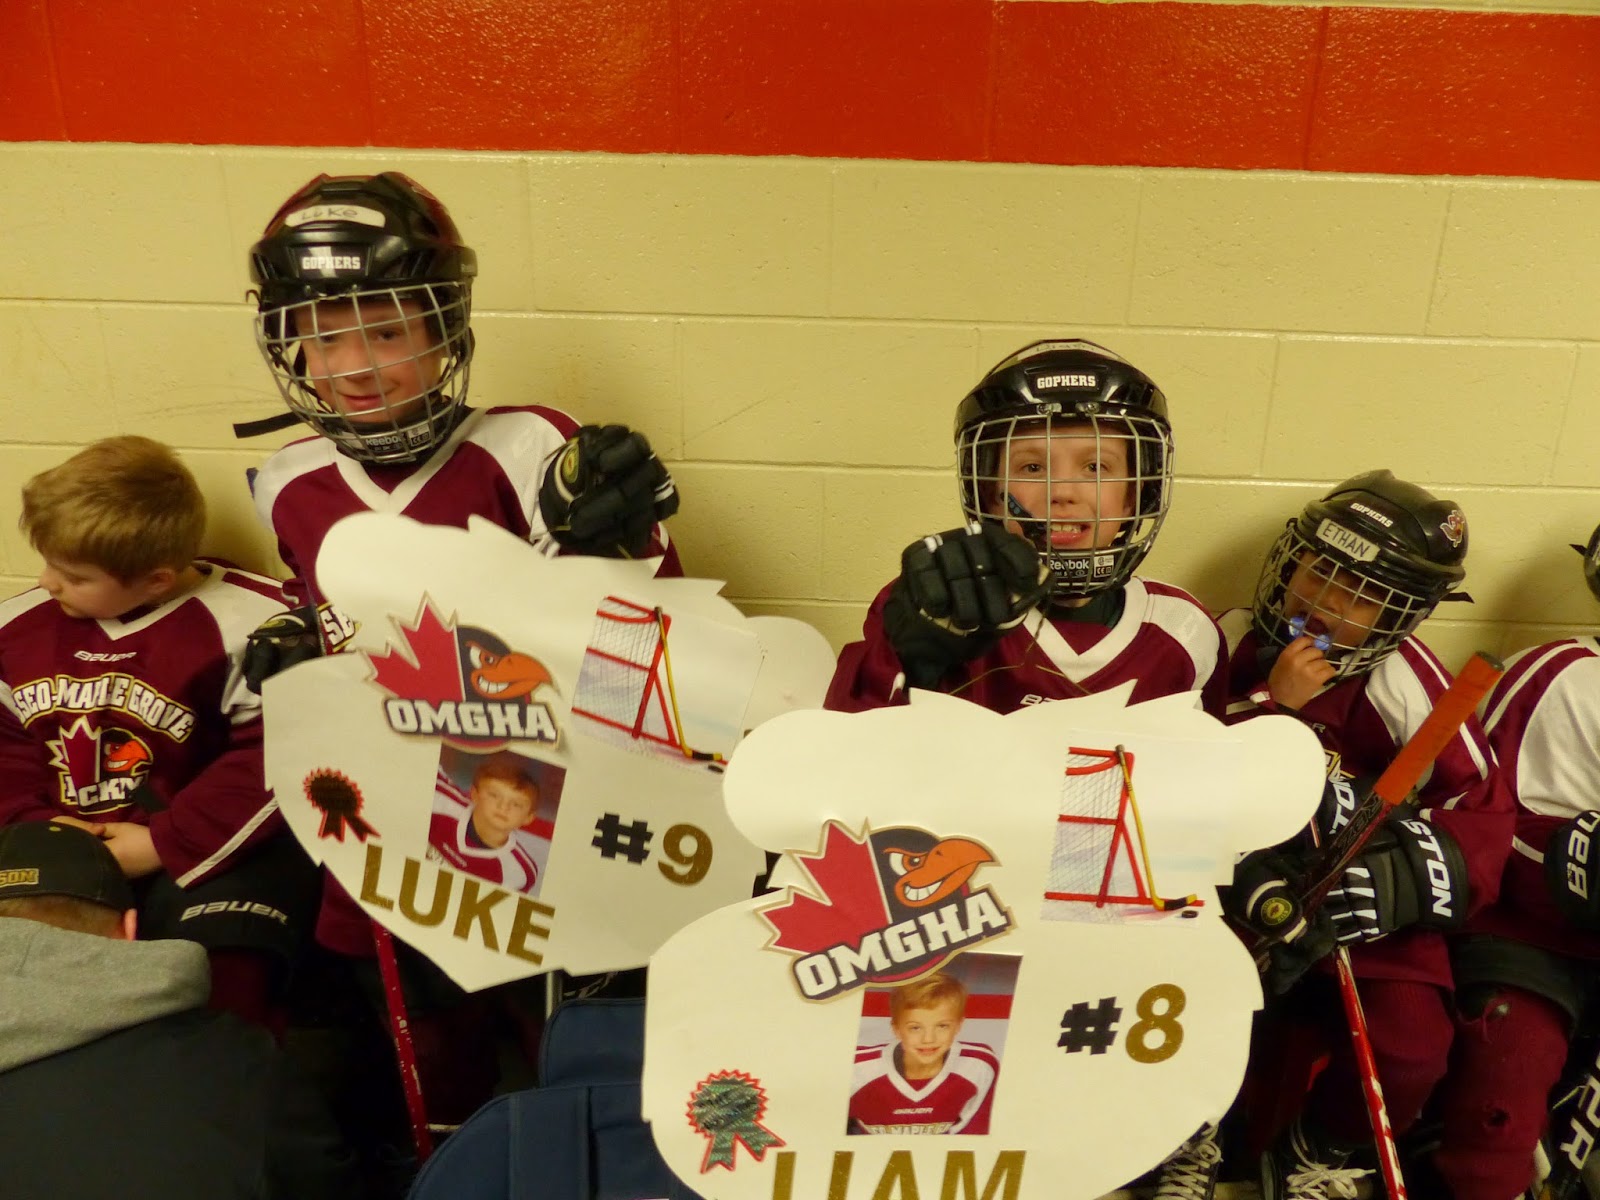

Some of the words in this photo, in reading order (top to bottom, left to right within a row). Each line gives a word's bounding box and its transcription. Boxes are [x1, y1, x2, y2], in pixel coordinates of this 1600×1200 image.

[302, 255, 361, 270] GOPHERS
[1037, 375, 1096, 389] GOPHERS
[365, 435, 405, 446] Reebo
[1350, 502, 1394, 528] GOPHERS
[1322, 522, 1371, 558] ETHAN
[128, 683, 195, 739] GROVE
[387, 699, 558, 741] OMGHA
[591, 812, 714, 887] #9
[1400, 818, 1453, 918] STON
[361, 843, 556, 966] LUKE
[797, 891, 1009, 998] OMGHA
[1057, 983, 1187, 1064] #8
